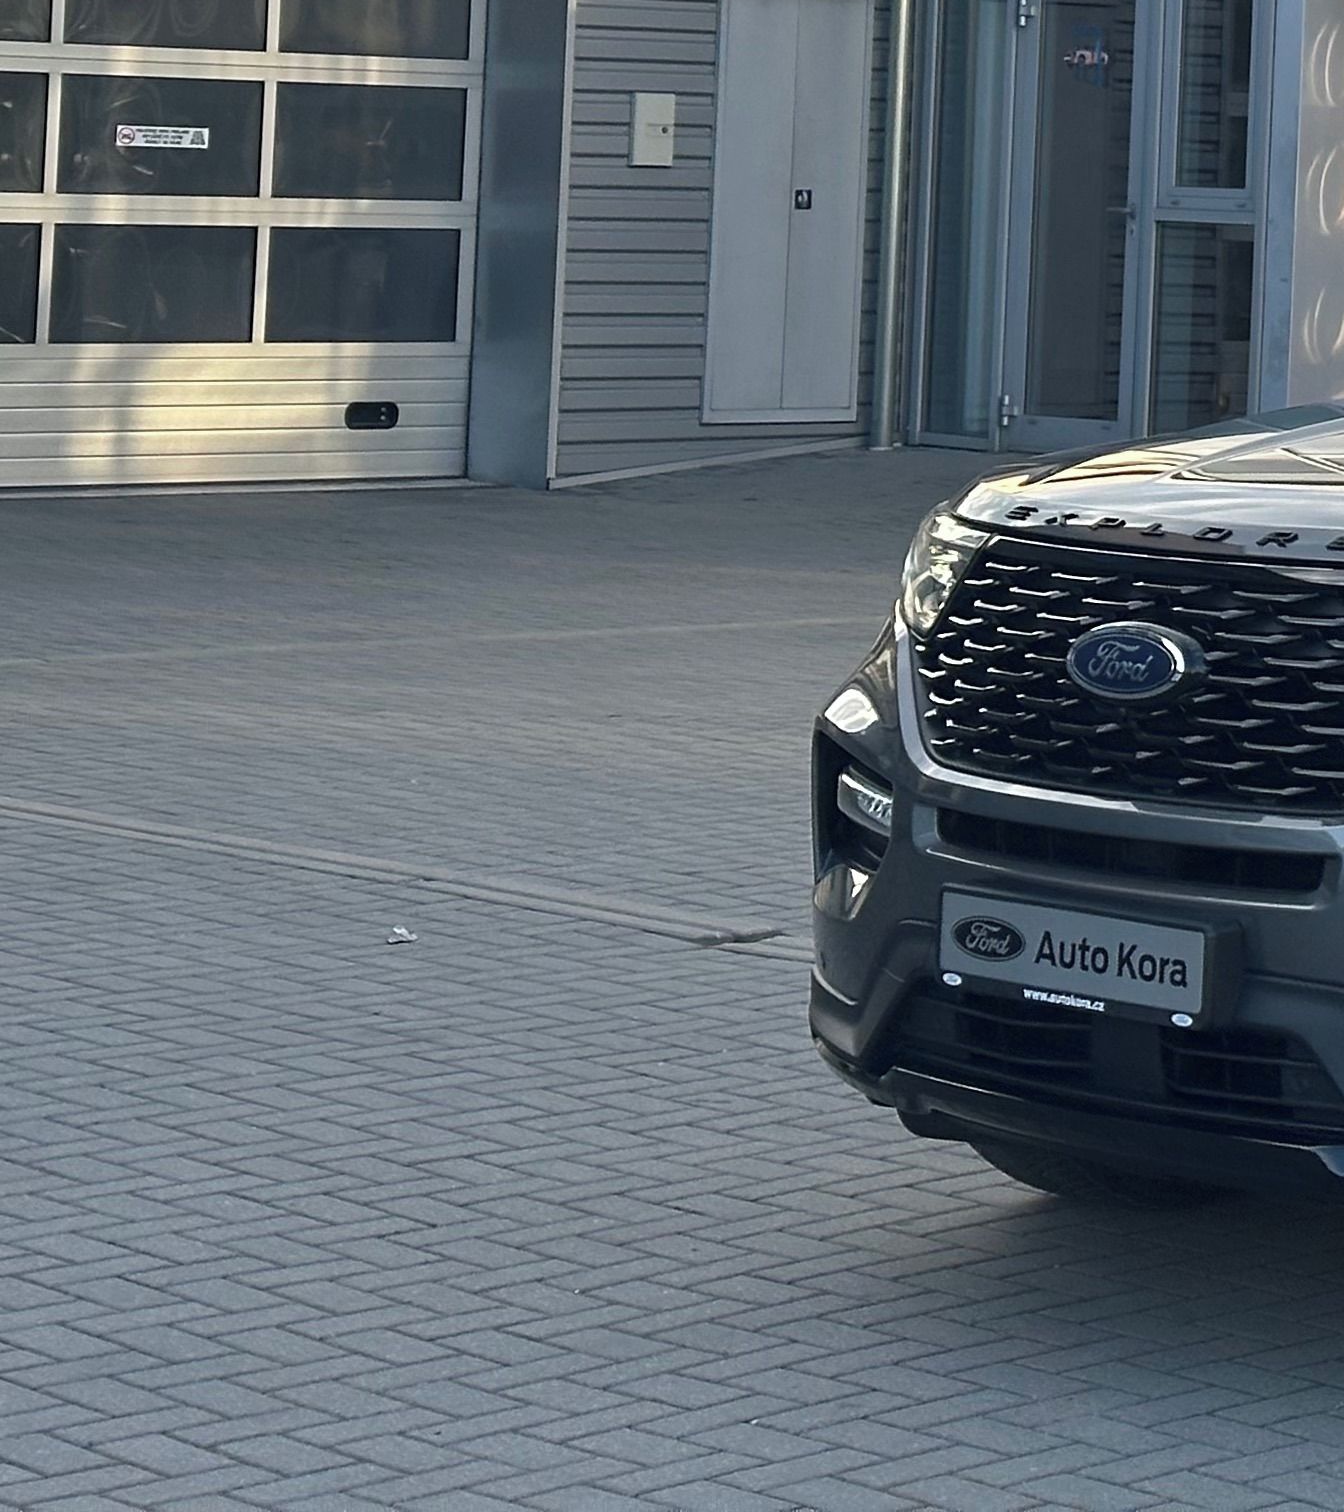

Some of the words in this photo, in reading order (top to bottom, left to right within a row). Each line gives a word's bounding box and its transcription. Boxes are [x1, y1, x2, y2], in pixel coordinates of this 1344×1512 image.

[1087, 640, 1154, 685] Ford
[965, 920, 1013, 956] Ford
[1033, 930, 1110, 975] Auto
[1116, 941, 1189, 989] Kora
